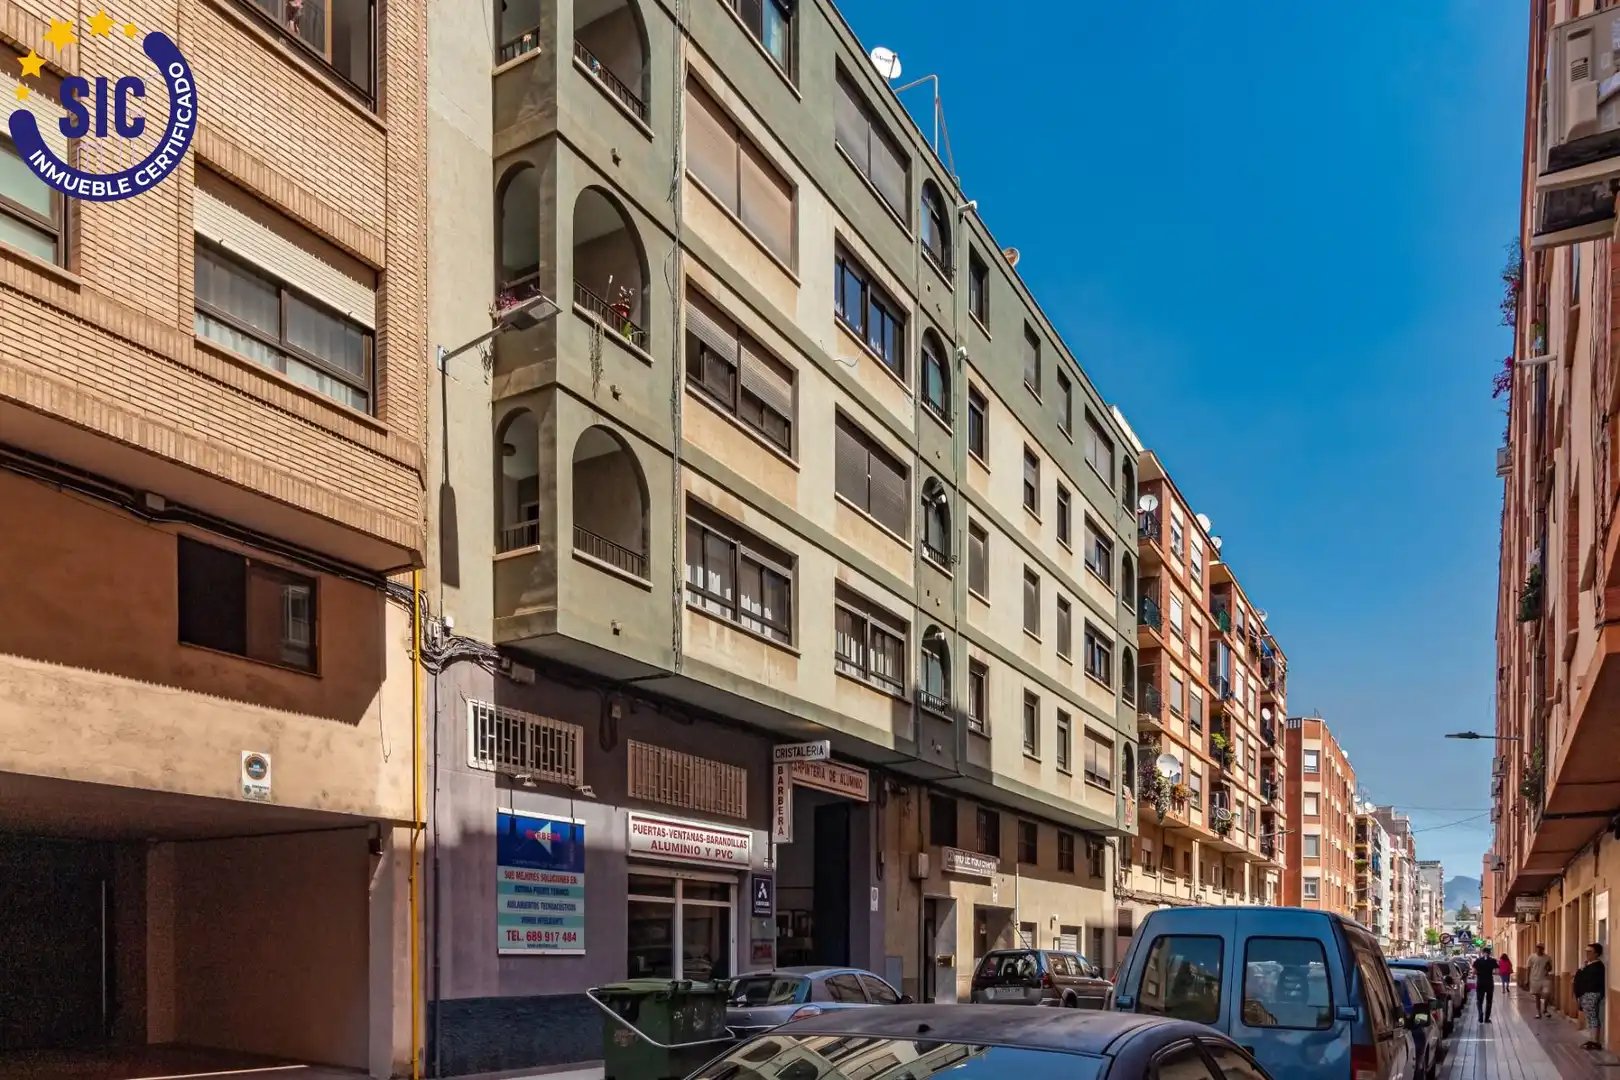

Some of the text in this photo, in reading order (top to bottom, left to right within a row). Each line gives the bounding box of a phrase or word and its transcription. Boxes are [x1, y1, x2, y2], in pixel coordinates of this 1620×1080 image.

[775, 745, 824, 758] CRISTALERIA
[651, 840, 733, 860] ALUMINIO Y PVC
[526, 930, 542, 942] 689
[544, 931, 560, 942] 917
